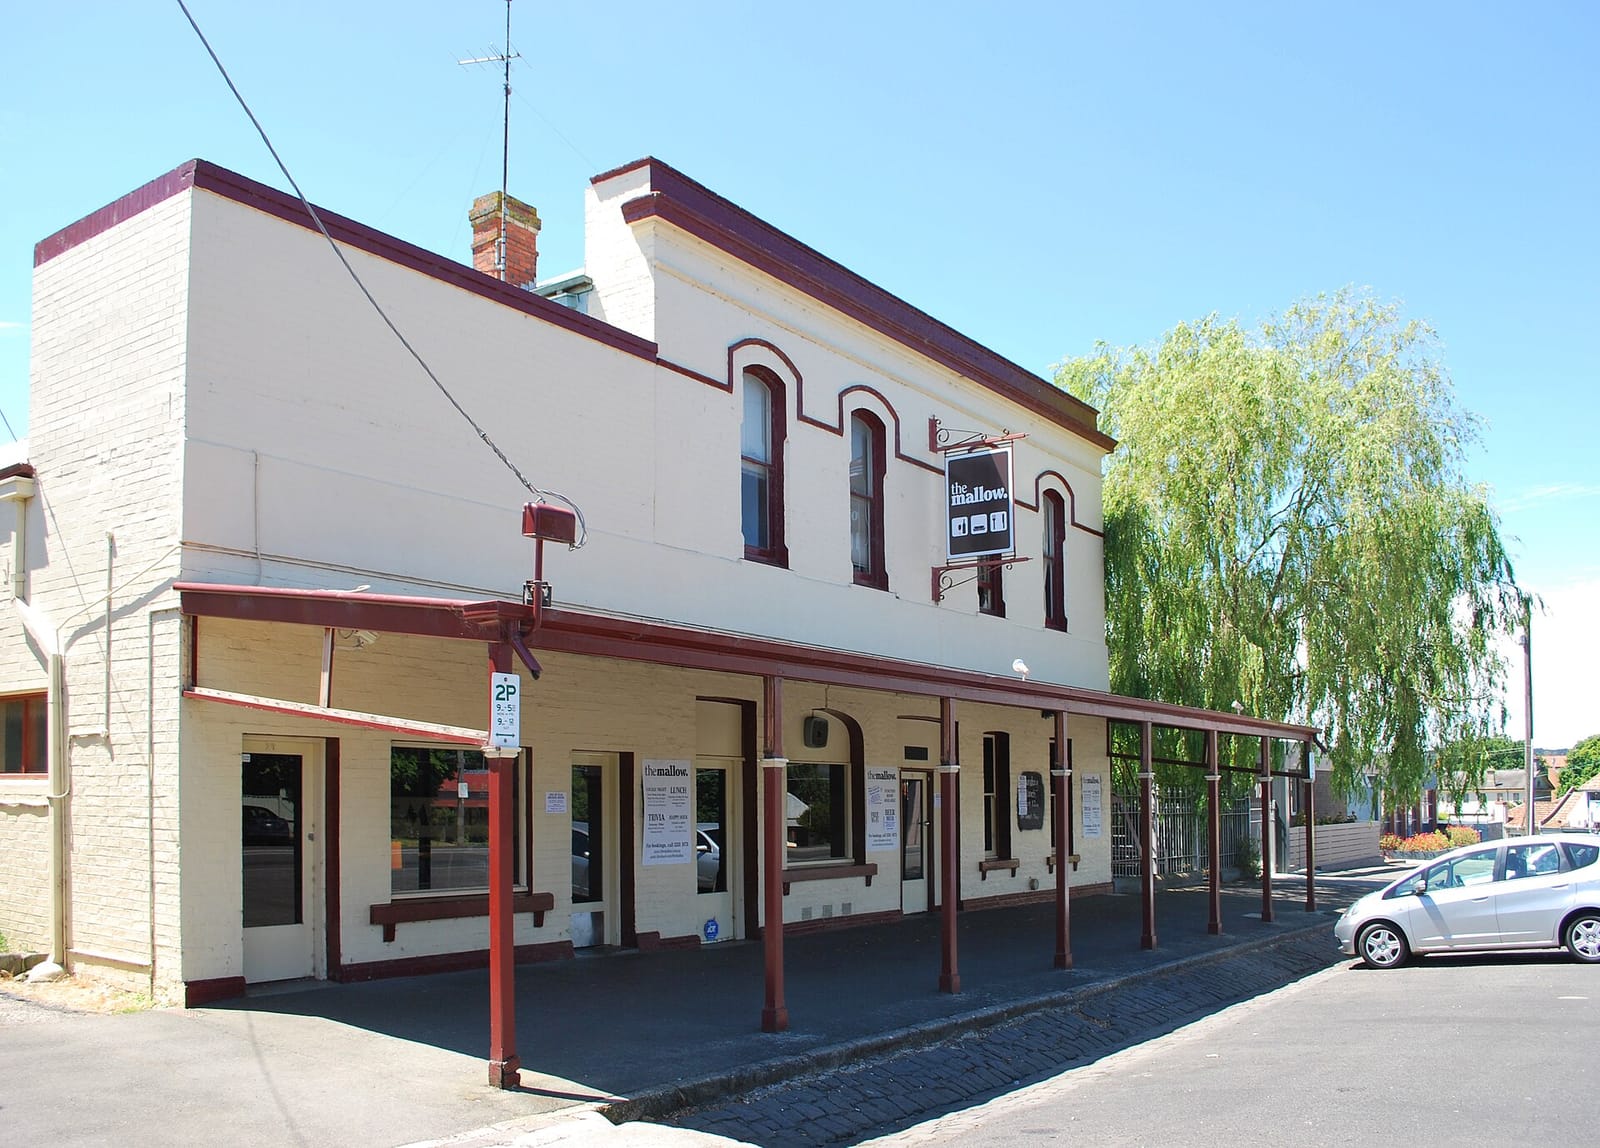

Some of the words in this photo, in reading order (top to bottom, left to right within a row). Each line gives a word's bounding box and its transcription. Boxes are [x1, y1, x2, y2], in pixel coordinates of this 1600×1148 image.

[951, 481, 968, 495] the
[951, 486, 1008, 506] mallow.
[495, 684, 517, 701] 2P
